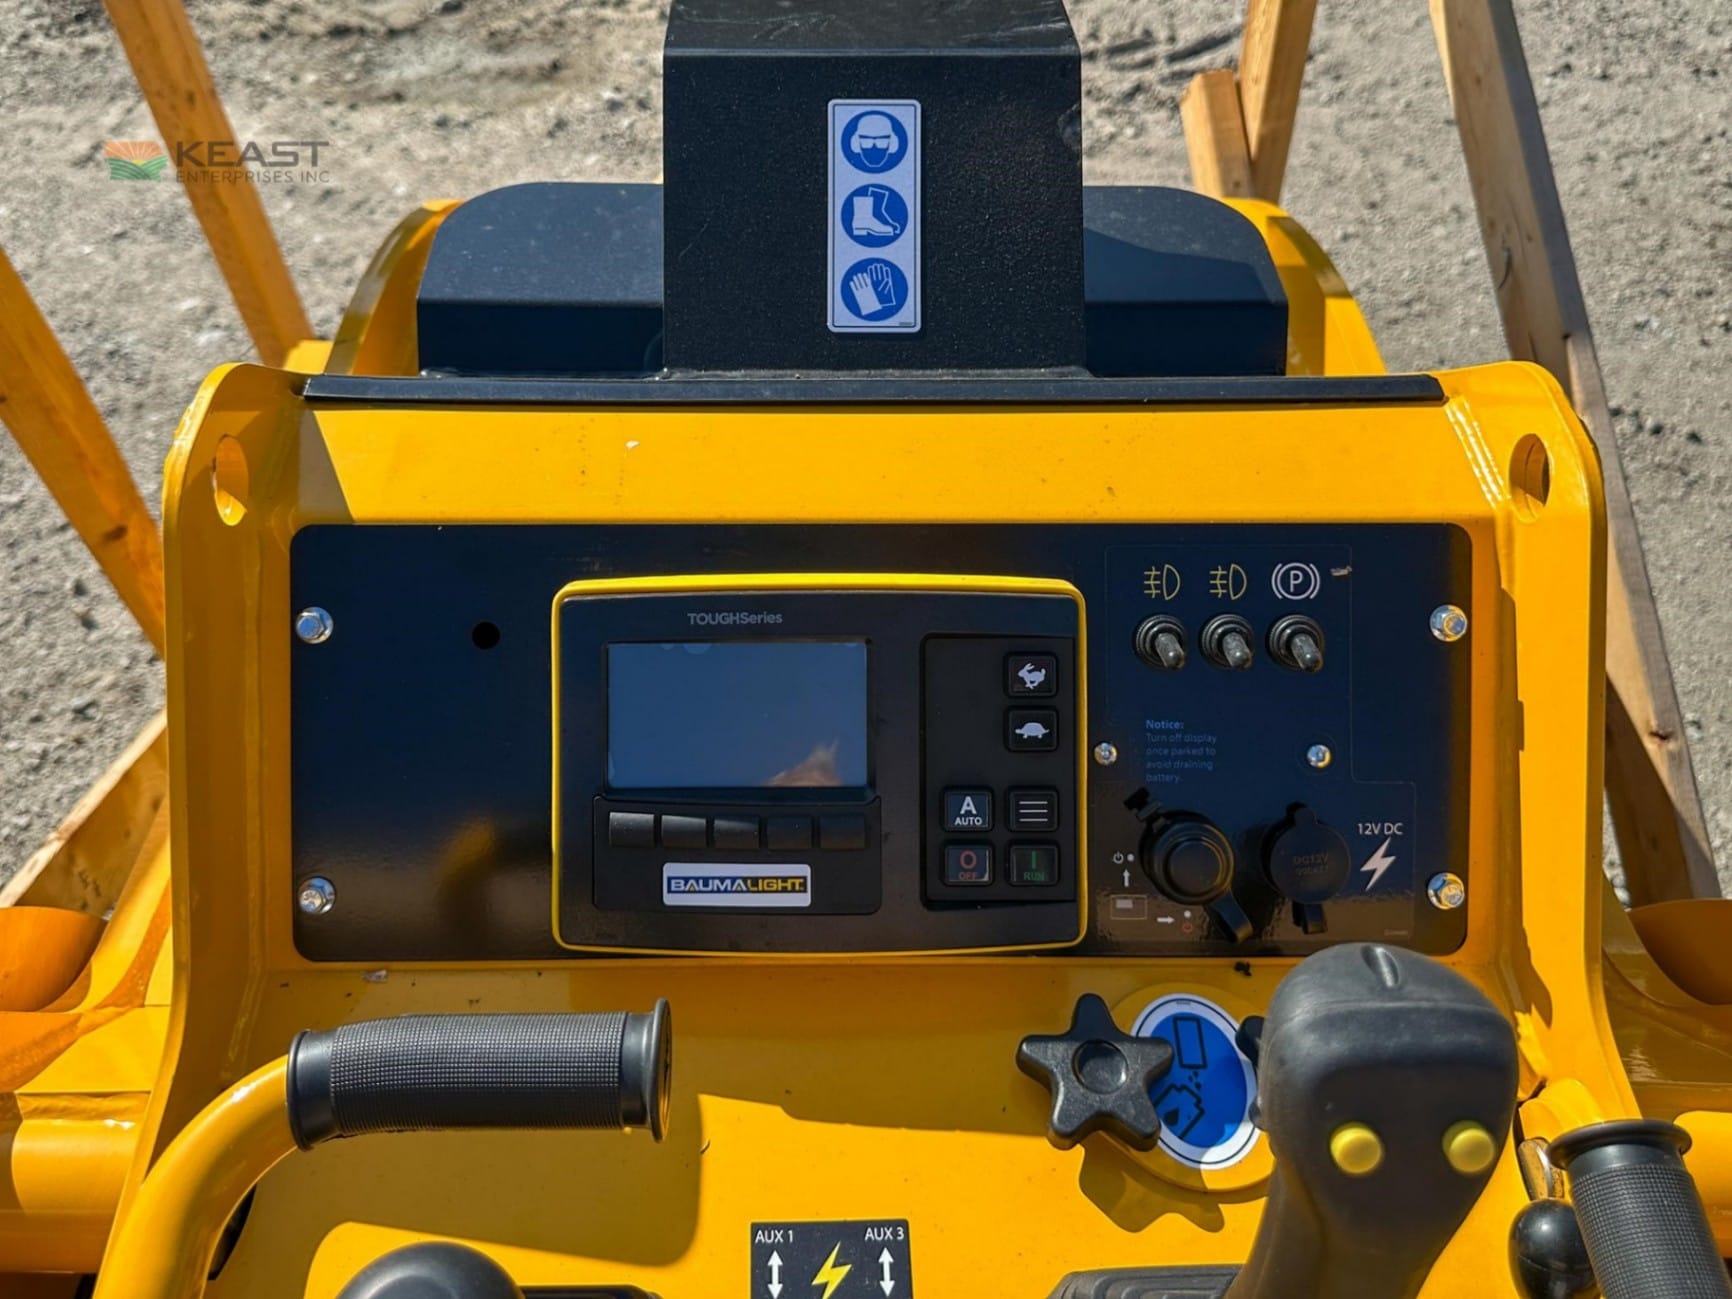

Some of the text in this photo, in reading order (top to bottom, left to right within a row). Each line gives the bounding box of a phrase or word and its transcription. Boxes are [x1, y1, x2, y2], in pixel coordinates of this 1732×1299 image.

[687, 612, 784, 625] TOUGHSeries
[1145, 719, 1184, 729] Notice:
[1145, 732, 1217, 745] Turn off display
[1170, 746, 1204, 758] parked
[1205, 746, 1217, 756] to
[1145, 759, 1213, 772] avoid draining
[960, 796, 977, 815] A
[954, 816, 983, 826] AUTO
[1357, 822, 1404, 836] 12V DC
[959, 871, 978, 881] OFF
[1024, 871, 1045, 881] RUN
[670, 877, 804, 892] BAUMALIGHT
[754, 1229, 794, 1243] AUX 1
[864, 1226, 905, 1241] AUX 3
